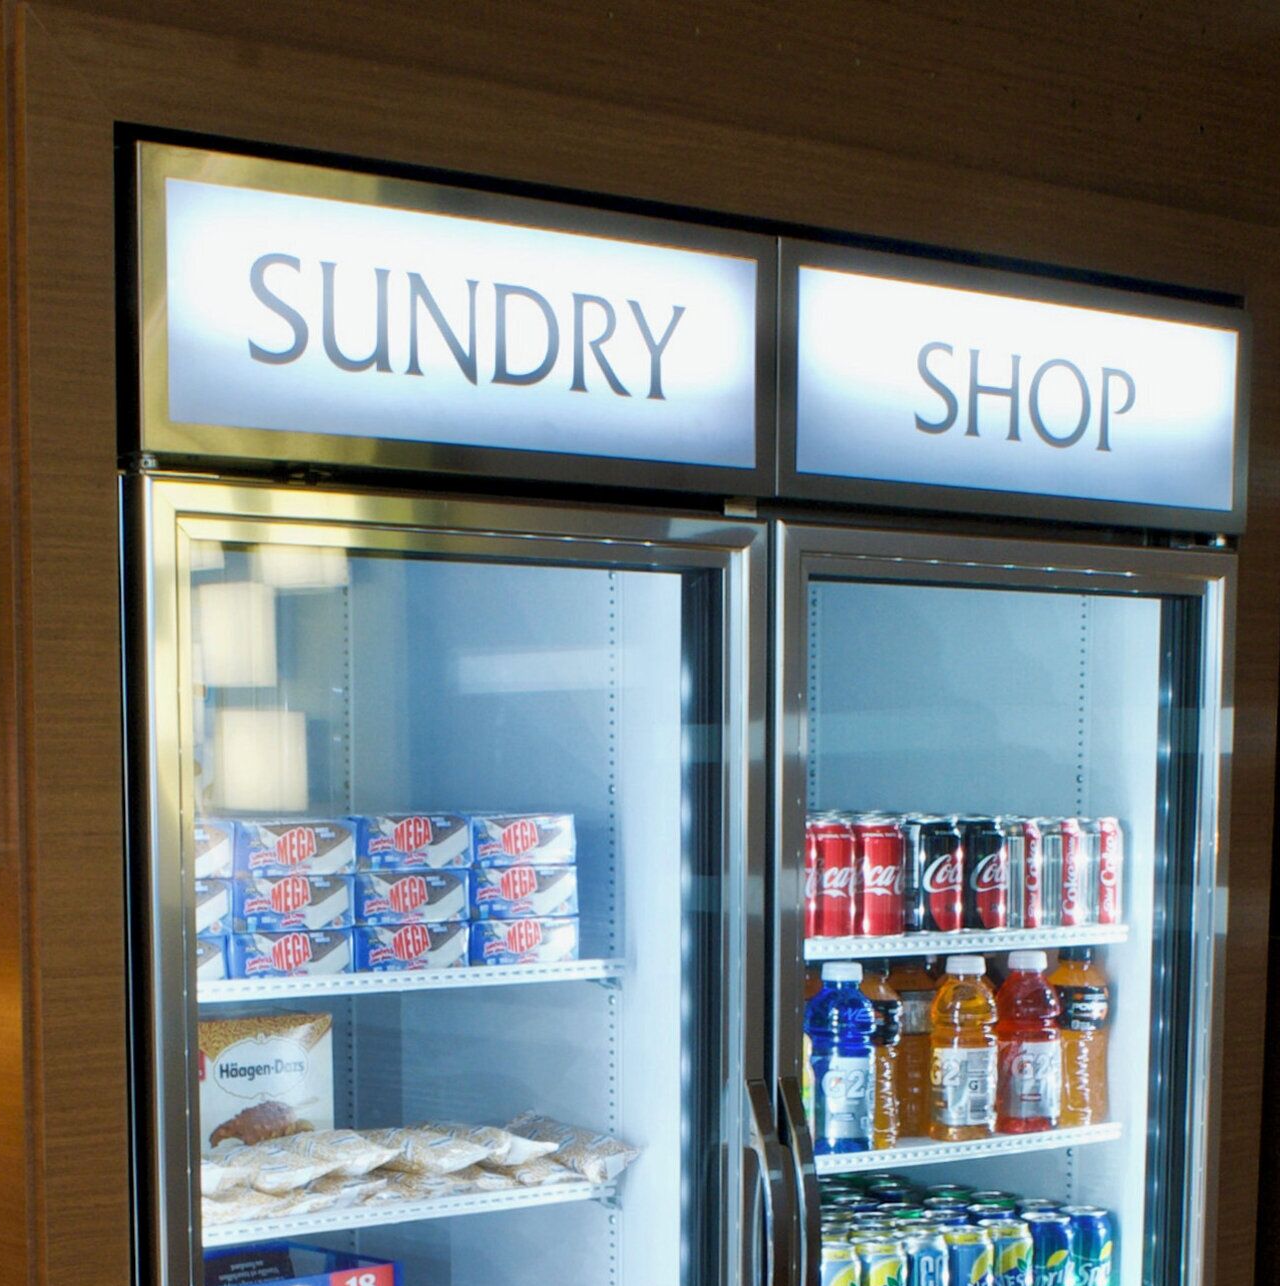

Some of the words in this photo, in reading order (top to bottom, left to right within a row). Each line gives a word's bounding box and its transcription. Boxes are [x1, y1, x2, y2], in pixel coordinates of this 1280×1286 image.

[247, 252, 686, 400] SUNDRY
[914, 341, 1136, 452] SHOP
[276, 827, 318, 865] MEGA
[394, 816, 433, 853] MEGA
[501, 819, 539, 855] MEGA
[271, 876, 312, 913] MEGA
[389, 876, 428, 913] MEGA
[501, 866, 538, 900] MEGA
[272, 933, 312, 972] MEGA
[393, 924, 432, 961] MEGA
[507, 919, 543, 954] MEGA
[219, 1059, 305, 1081] Häagen-Dazs
[823, 1070, 866, 1099] G2
